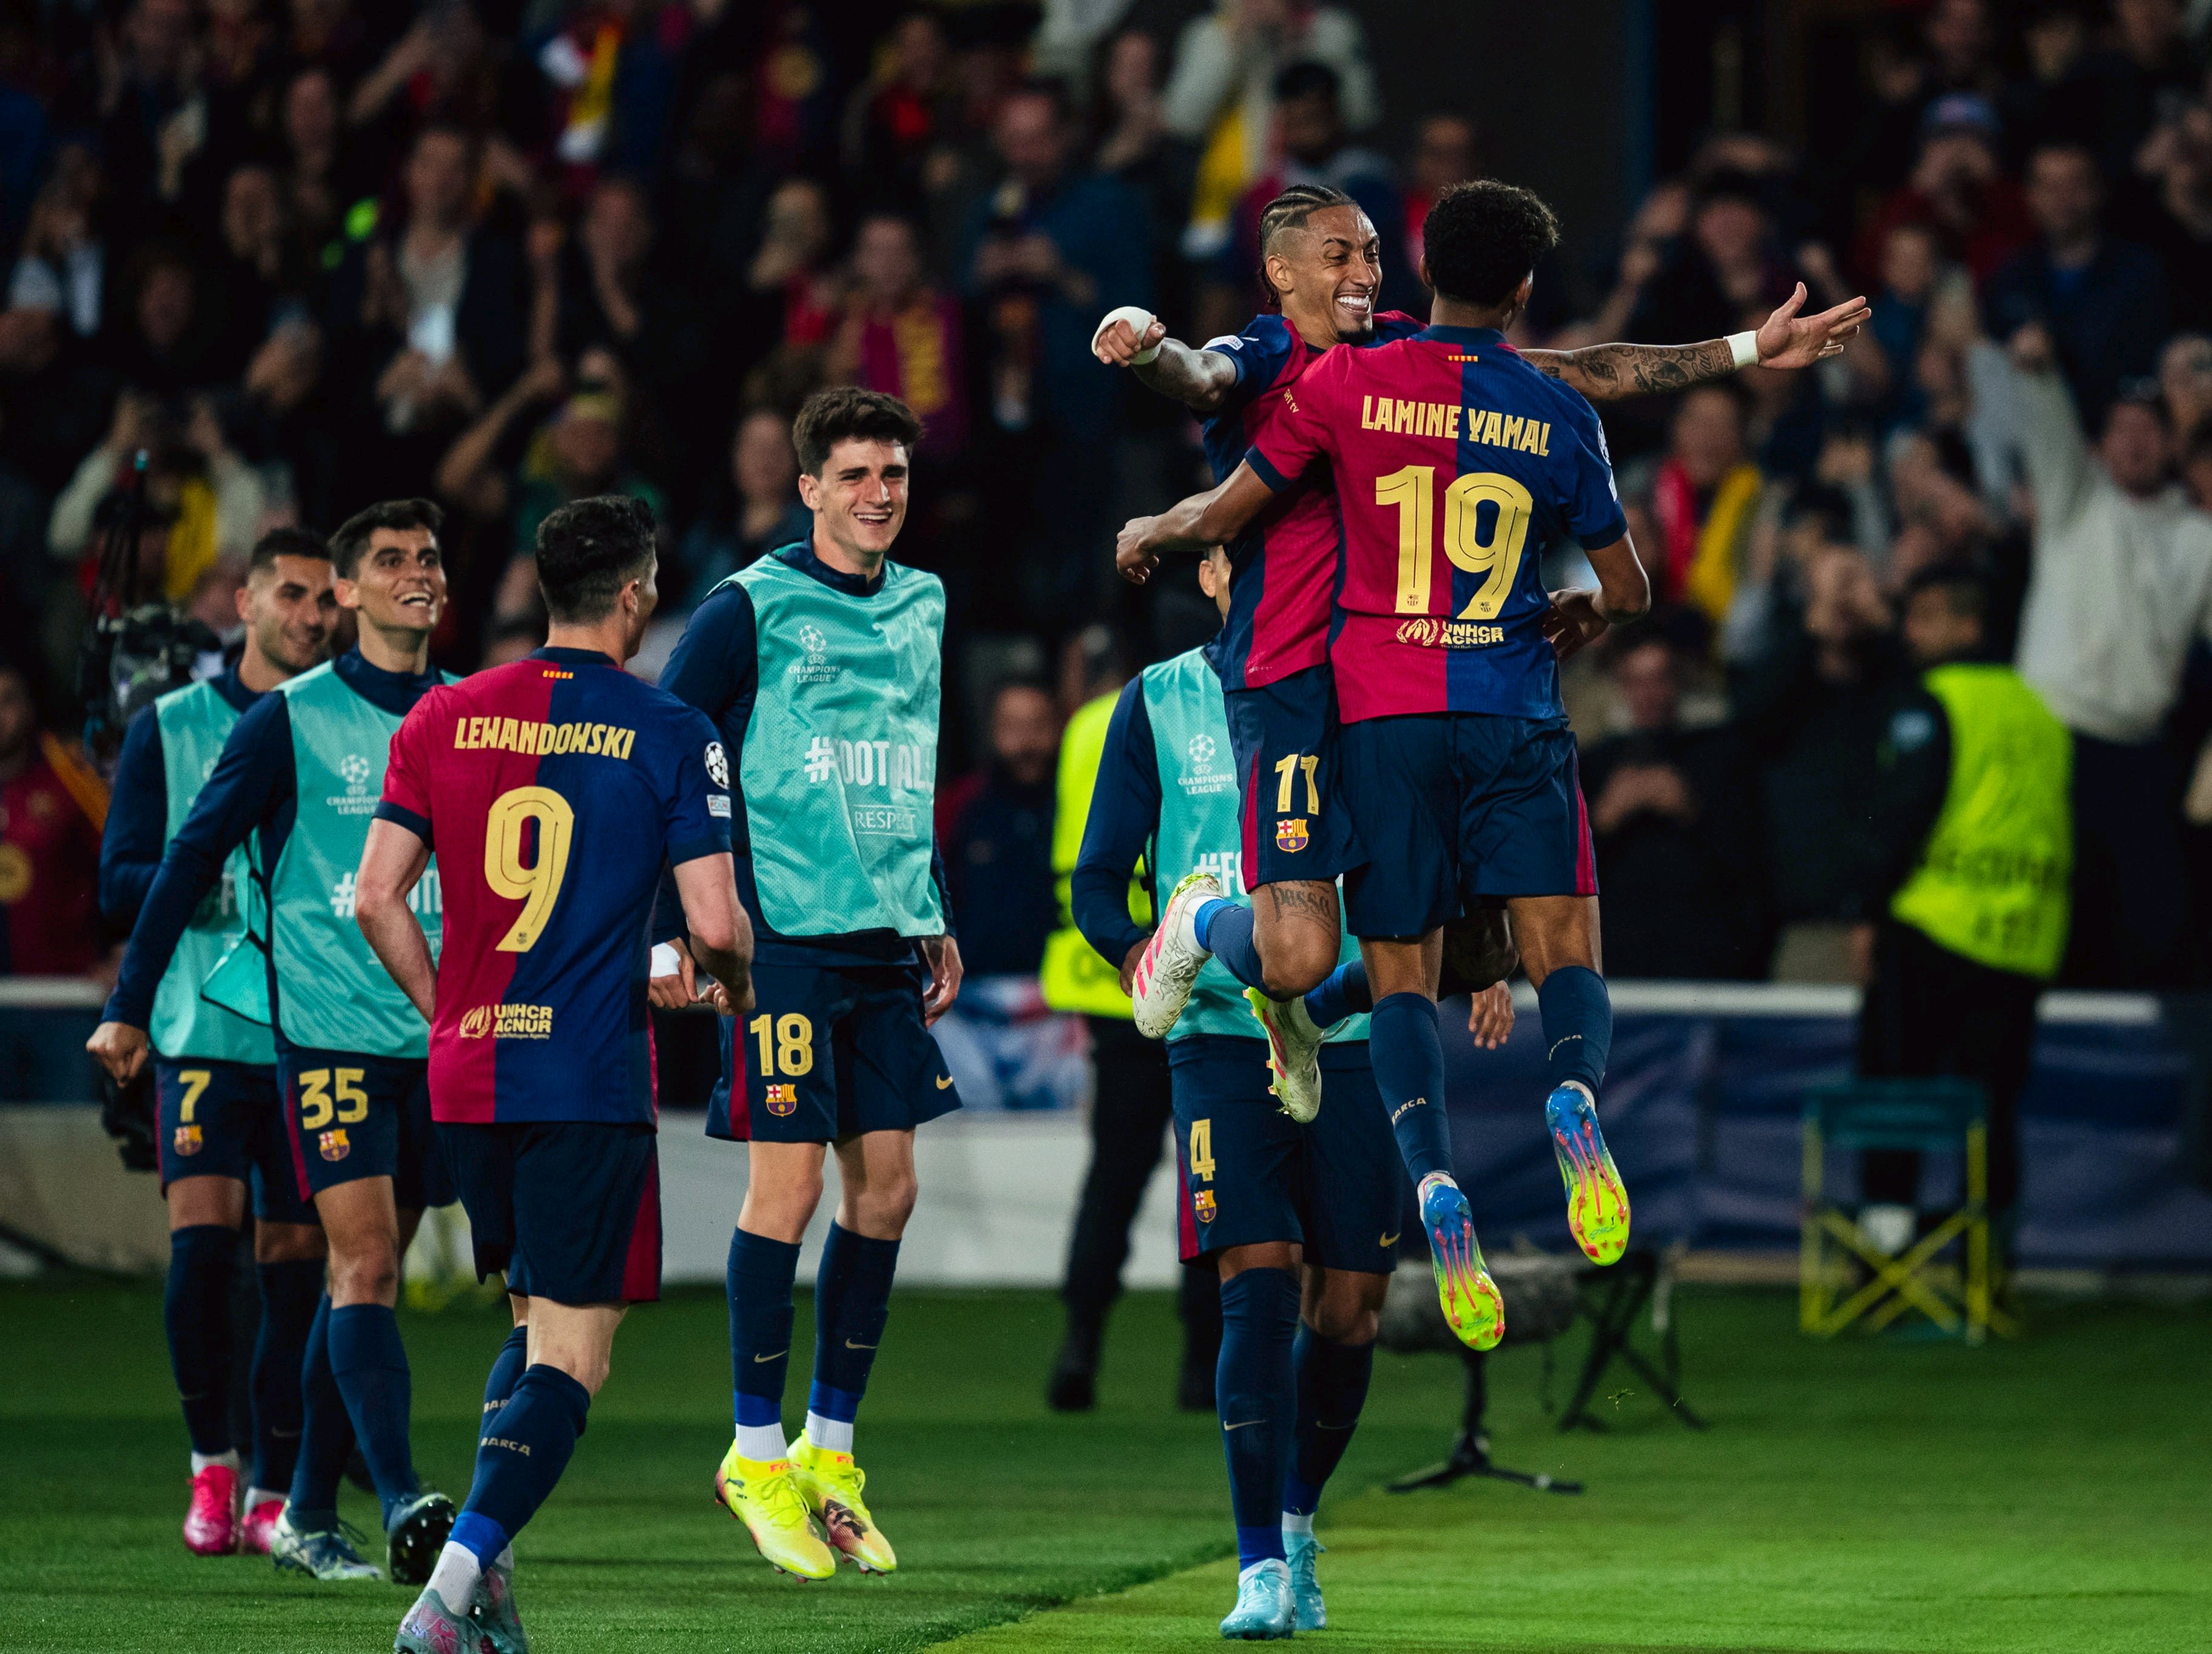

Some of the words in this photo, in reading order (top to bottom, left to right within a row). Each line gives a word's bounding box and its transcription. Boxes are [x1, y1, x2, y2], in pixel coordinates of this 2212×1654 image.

[1362, 395, 1462, 439] LAMINE
[1468, 408, 1550, 457] YAMAL
[1376, 465, 1533, 620] 19
[797, 674, 831, 683] LEAGUE
[454, 717, 636, 760] LEWANDOWSKI
[1178, 774, 1232, 785] CHAMPIONS
[1186, 784, 1223, 795] LEAGUE
[1275, 754, 1319, 815] 11
[485, 786, 574, 952] 9
[493, 1018, 551, 1033] ACNUR
[494, 1003, 553, 1020] UNHCR
[750, 1013, 813, 1076] 18
[179, 1071, 210, 1121] 7
[299, 1068, 368, 1129] 35
[1190, 1119, 1215, 1182] 4
